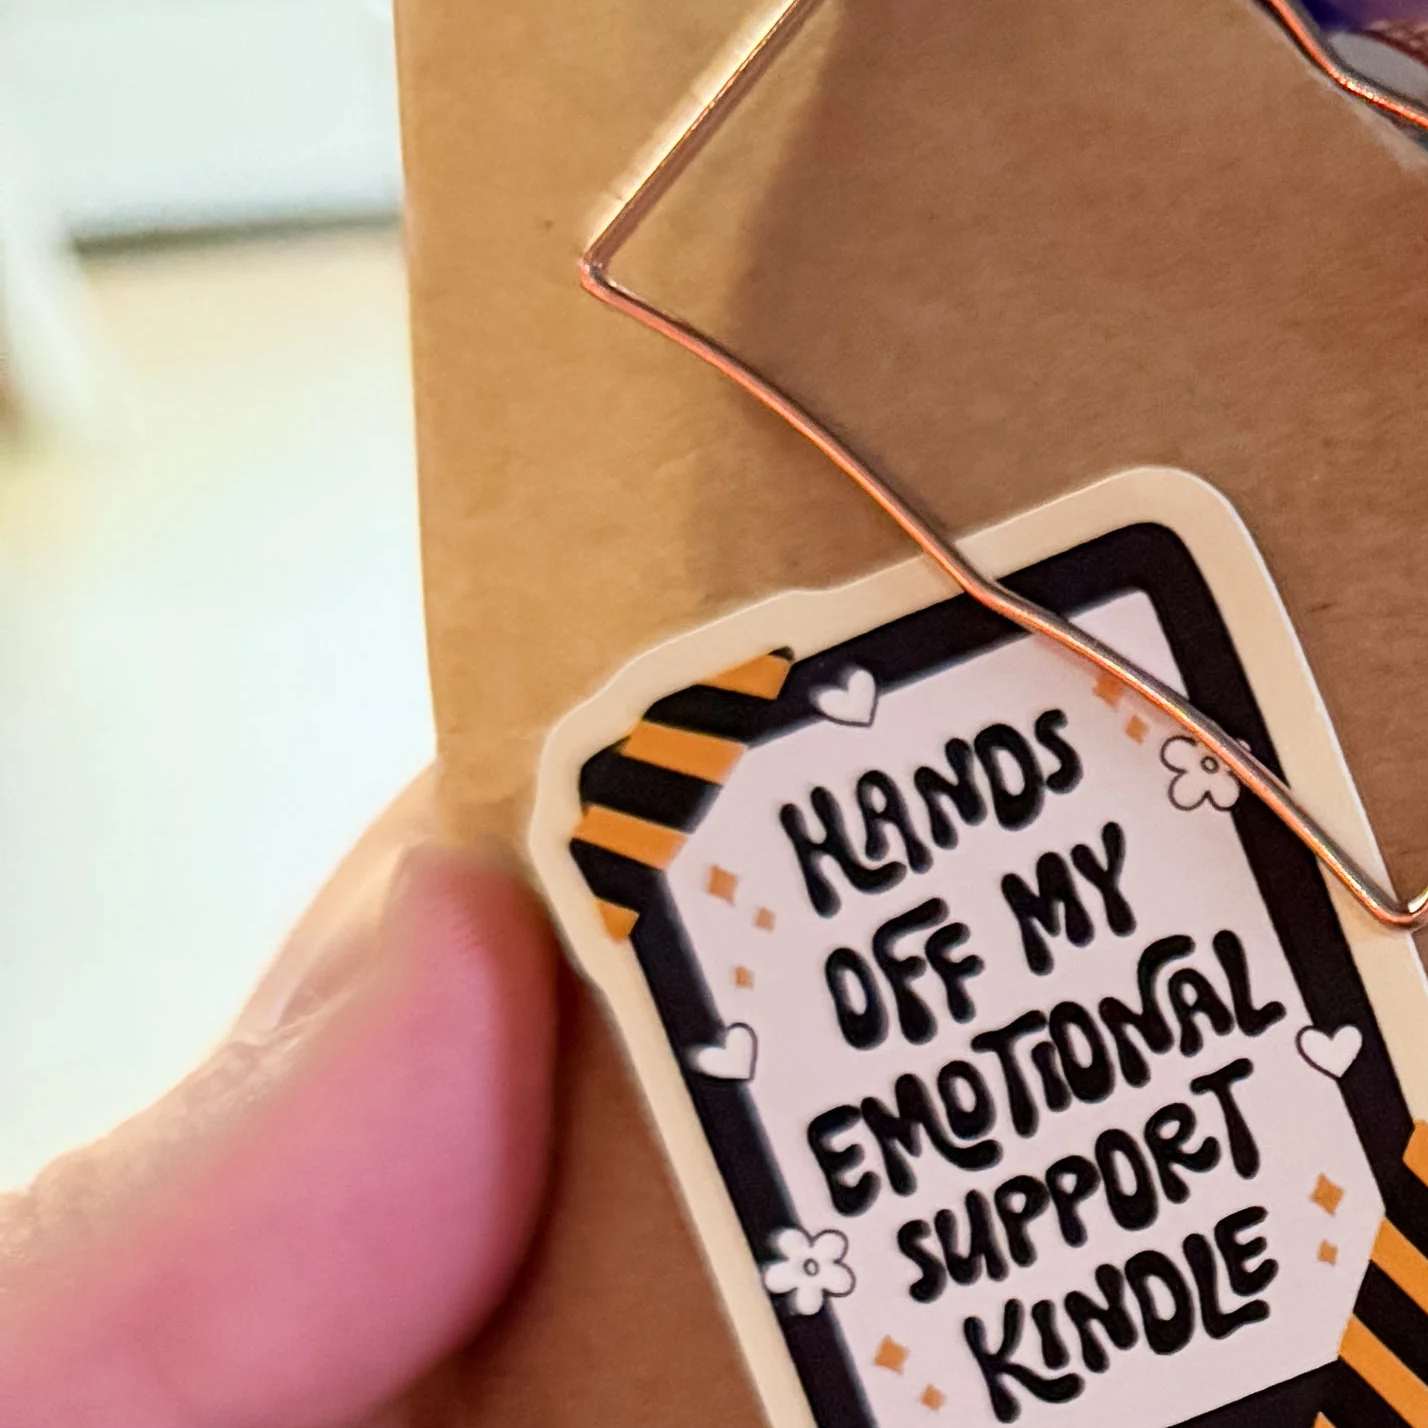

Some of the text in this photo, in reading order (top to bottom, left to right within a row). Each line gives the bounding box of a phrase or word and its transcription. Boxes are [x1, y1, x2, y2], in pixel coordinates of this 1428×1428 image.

[778, 708, 1084, 918] HANDS
[824, 820, 1140, 1050] OFF MY
[804, 928, 1288, 1218] EMOTIONAL
[892, 1056, 1260, 1304] SUPPORT
[960, 1204, 1282, 1424] KINDLE
